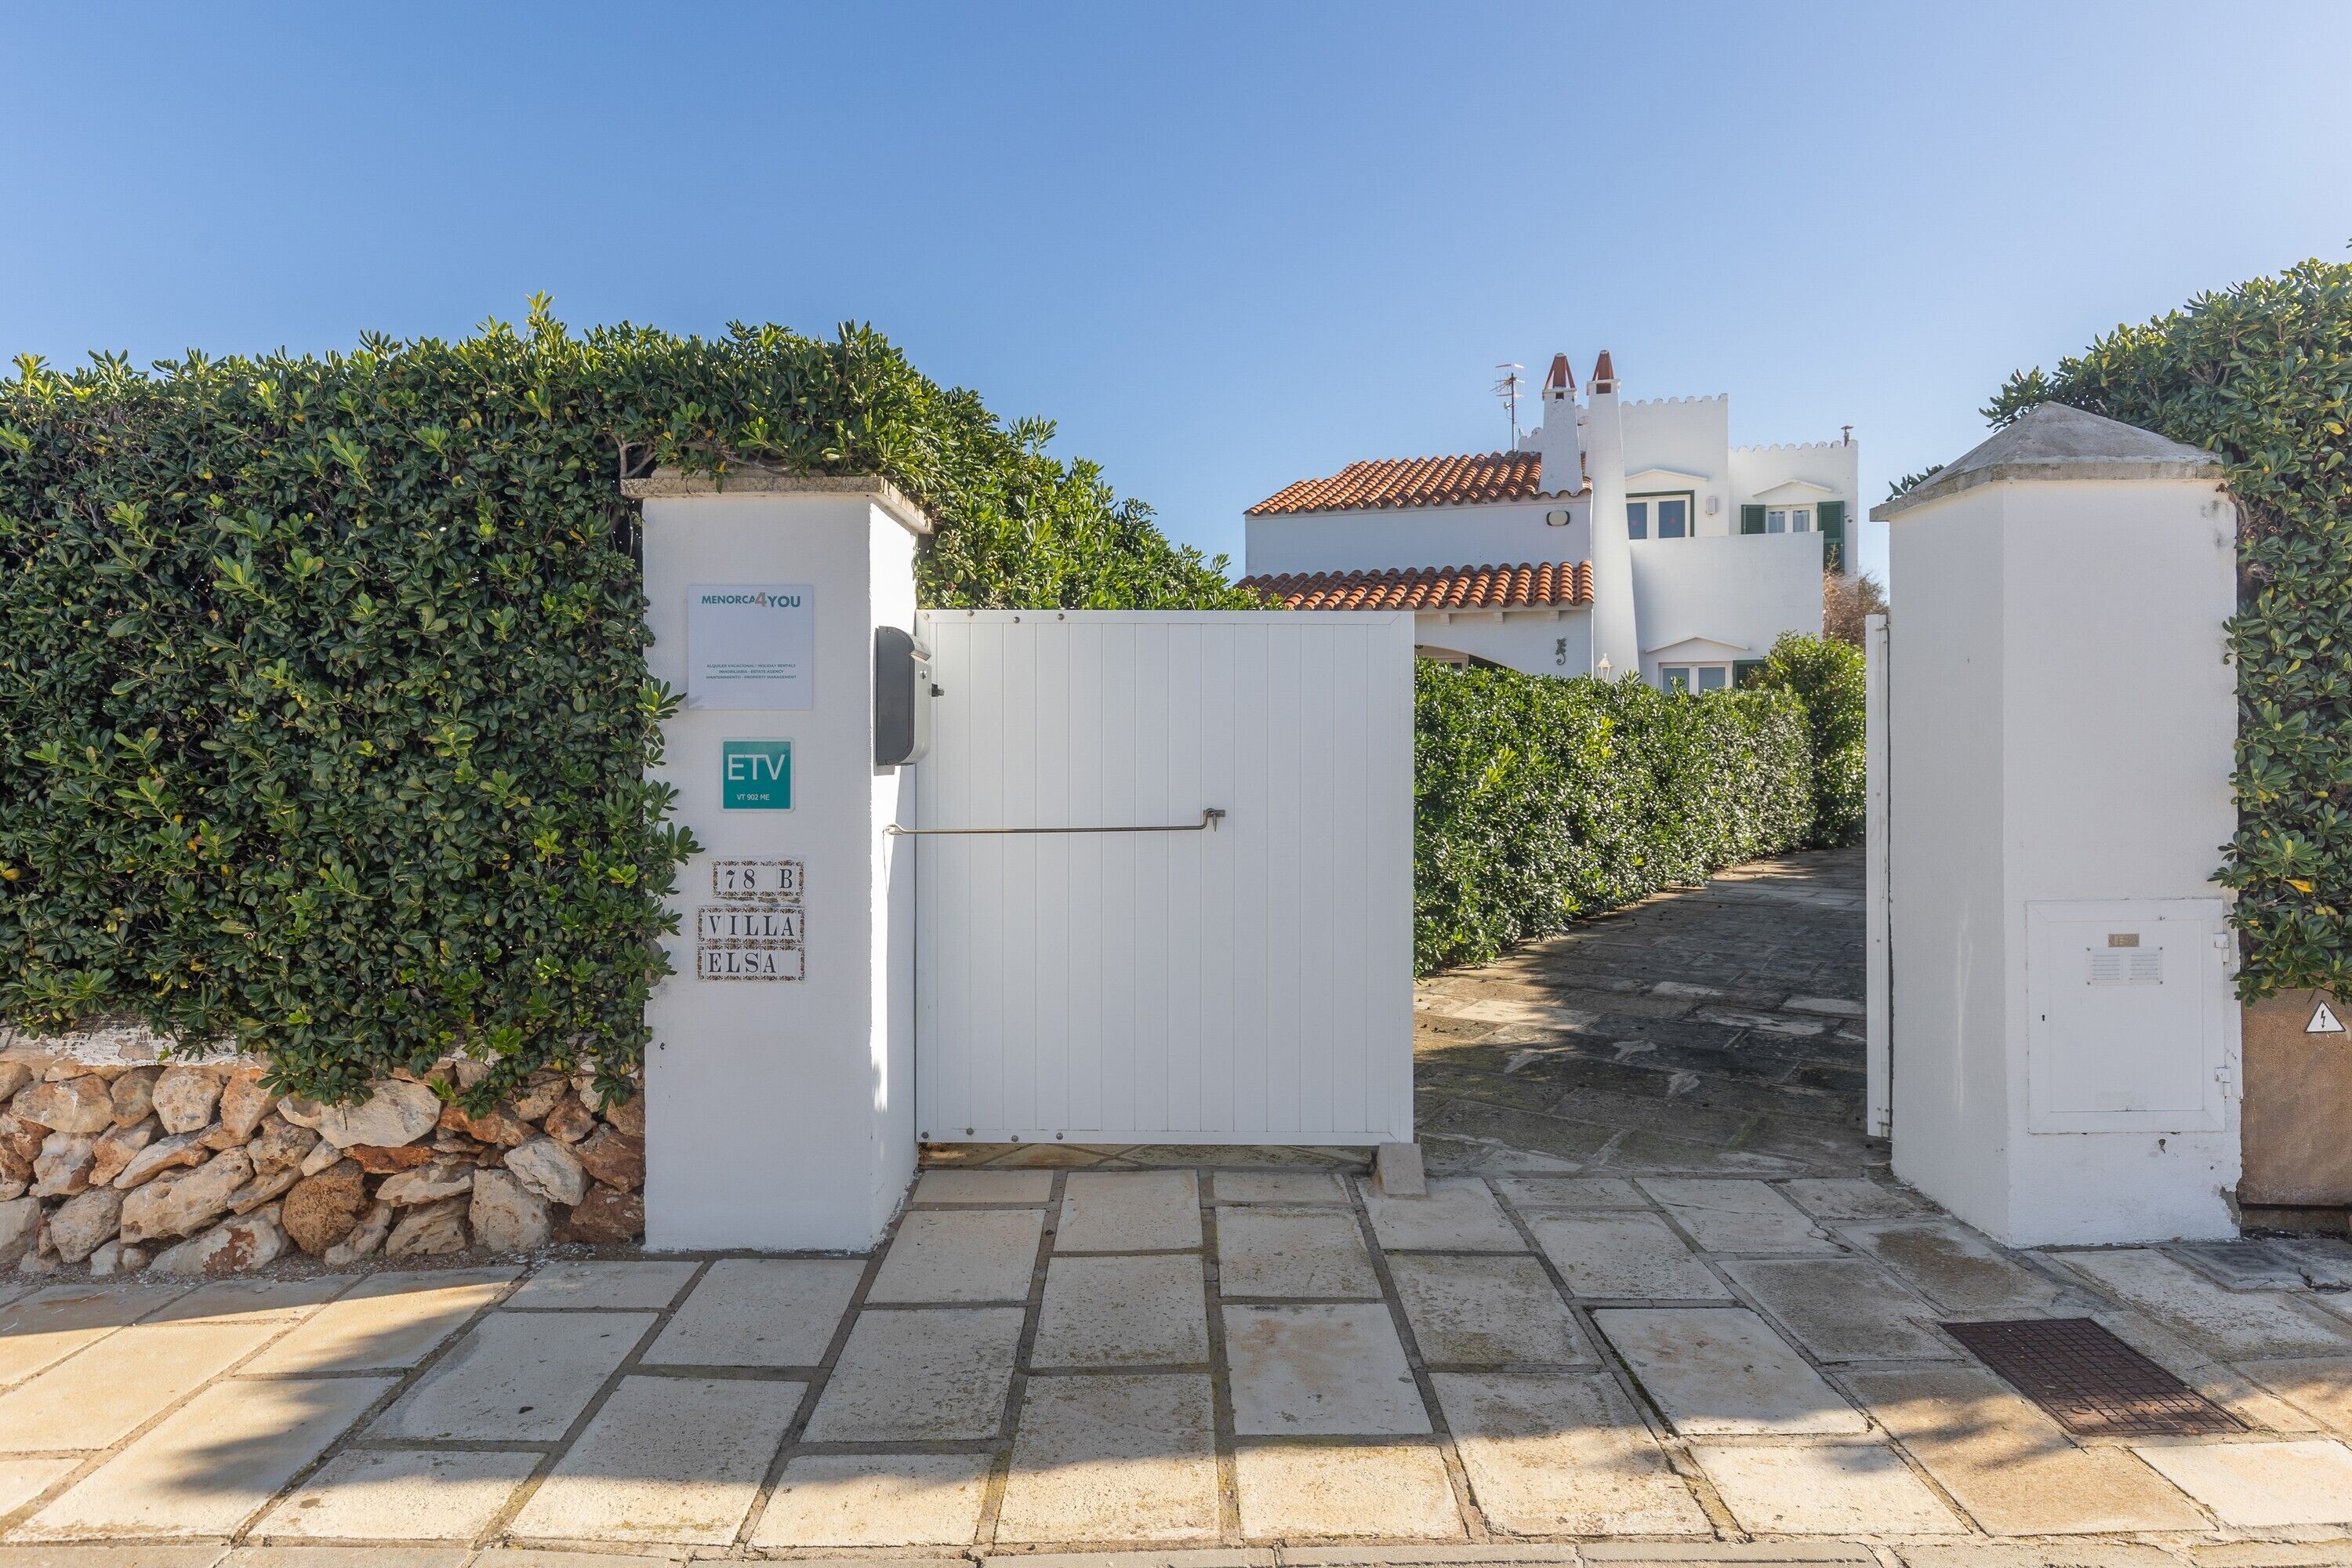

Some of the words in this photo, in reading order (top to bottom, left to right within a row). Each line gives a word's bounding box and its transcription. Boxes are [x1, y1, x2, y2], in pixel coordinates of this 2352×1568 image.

[701, 592, 801, 608] MENORCA4YOU
[728, 754, 786, 780] ETV
[725, 869, 755, 889] 78
[779, 869, 793, 889] B
[709, 915, 795, 936] VILLA
[708, 952, 776, 973] ELSA
